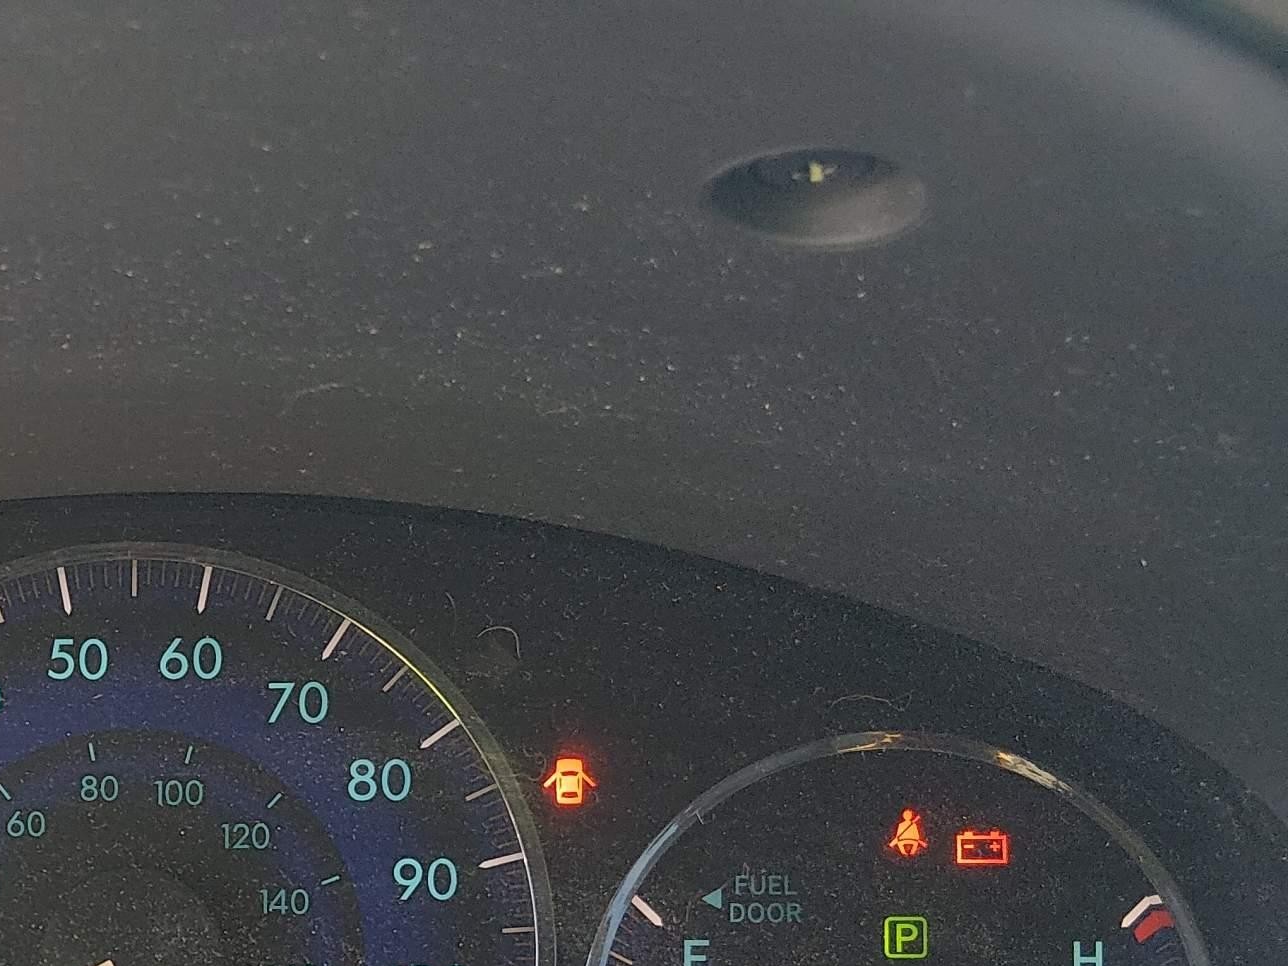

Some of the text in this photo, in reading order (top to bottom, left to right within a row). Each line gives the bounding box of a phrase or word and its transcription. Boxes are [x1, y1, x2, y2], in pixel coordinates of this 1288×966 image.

[48, 638, 109, 680] 50
[160, 637, 223, 680] 60
[268, 682, 328, 724] 70
[80, 776, 119, 802] 80
[155, 780, 203, 806] 100
[349, 759, 411, 801] 80
[7, 811, 45, 837] 60
[223, 823, 270, 849] 120
[393, 858, 457, 901] 90
[734, 876, 798, 895] FUEL
[261, 889, 309, 915] 140
[730, 904, 801, 922] DOOR
[896, 924, 917, 952] P
